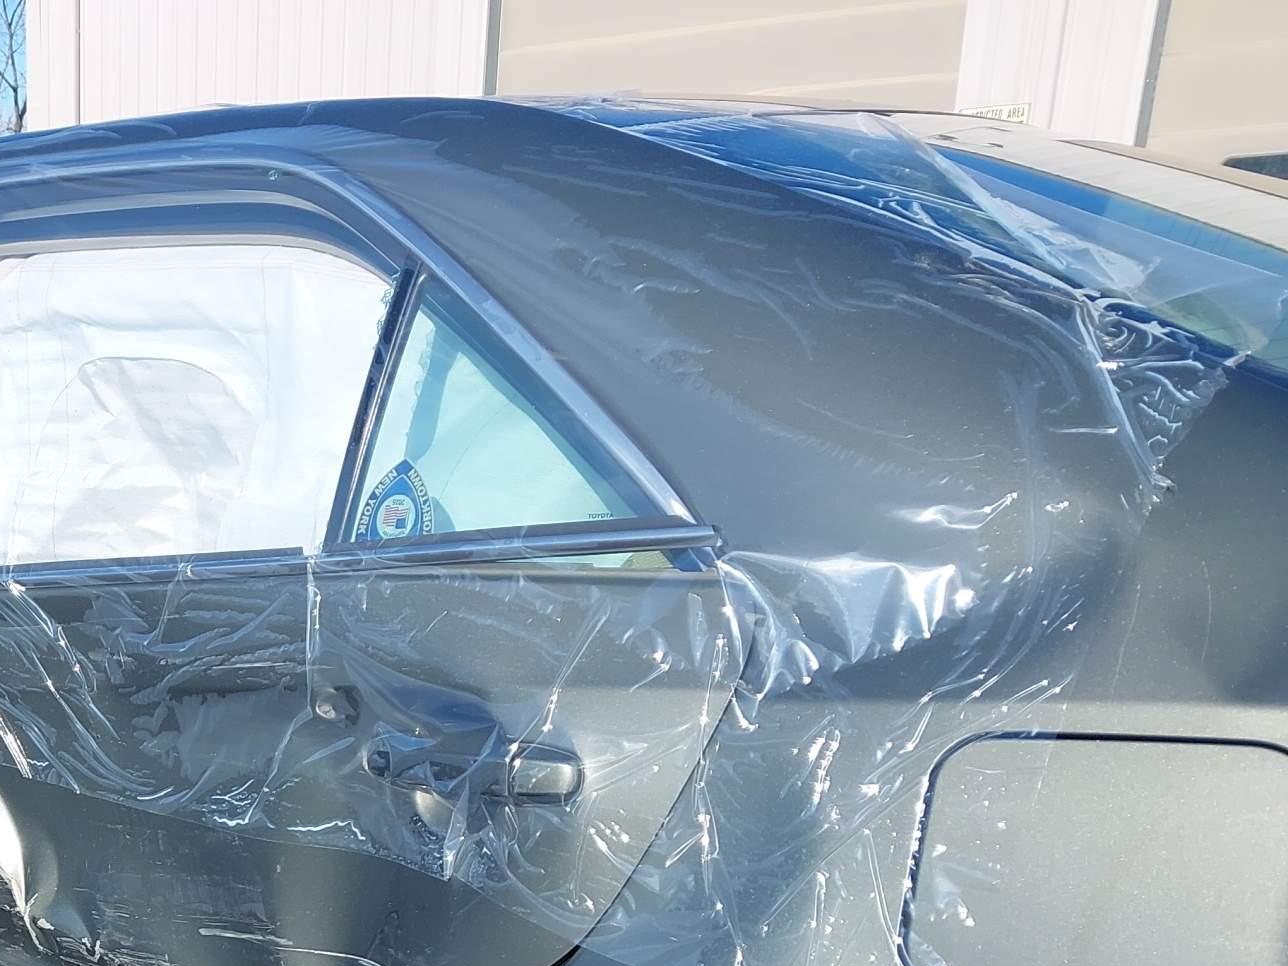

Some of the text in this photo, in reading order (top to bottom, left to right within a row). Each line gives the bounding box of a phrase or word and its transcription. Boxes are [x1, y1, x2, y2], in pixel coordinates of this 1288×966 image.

[1007, 106, 1025, 119] AREA
[375, 468, 398, 496] NEW
[357, 499, 377, 534] YORK
